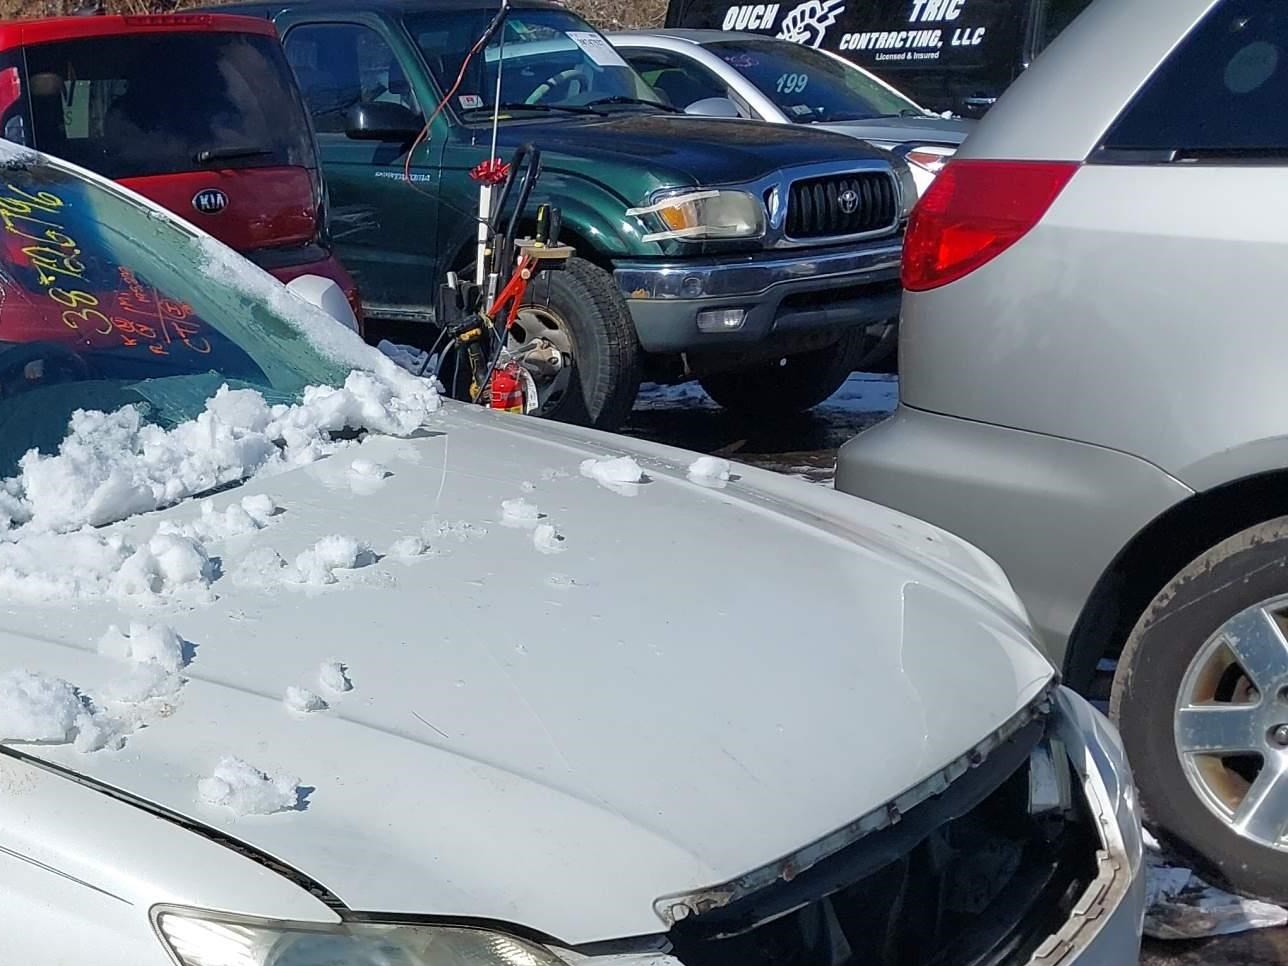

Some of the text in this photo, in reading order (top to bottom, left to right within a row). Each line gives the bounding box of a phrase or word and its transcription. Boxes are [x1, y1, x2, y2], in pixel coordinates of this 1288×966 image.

[722, 0, 964, 31] OUCH TRIC
[839, 27, 986, 50] CONTRACTING, LLC
[875, 51, 940, 60] Licensed & Insured
[776, 73, 808, 93] 199
[199, 193, 225, 209] KIA
